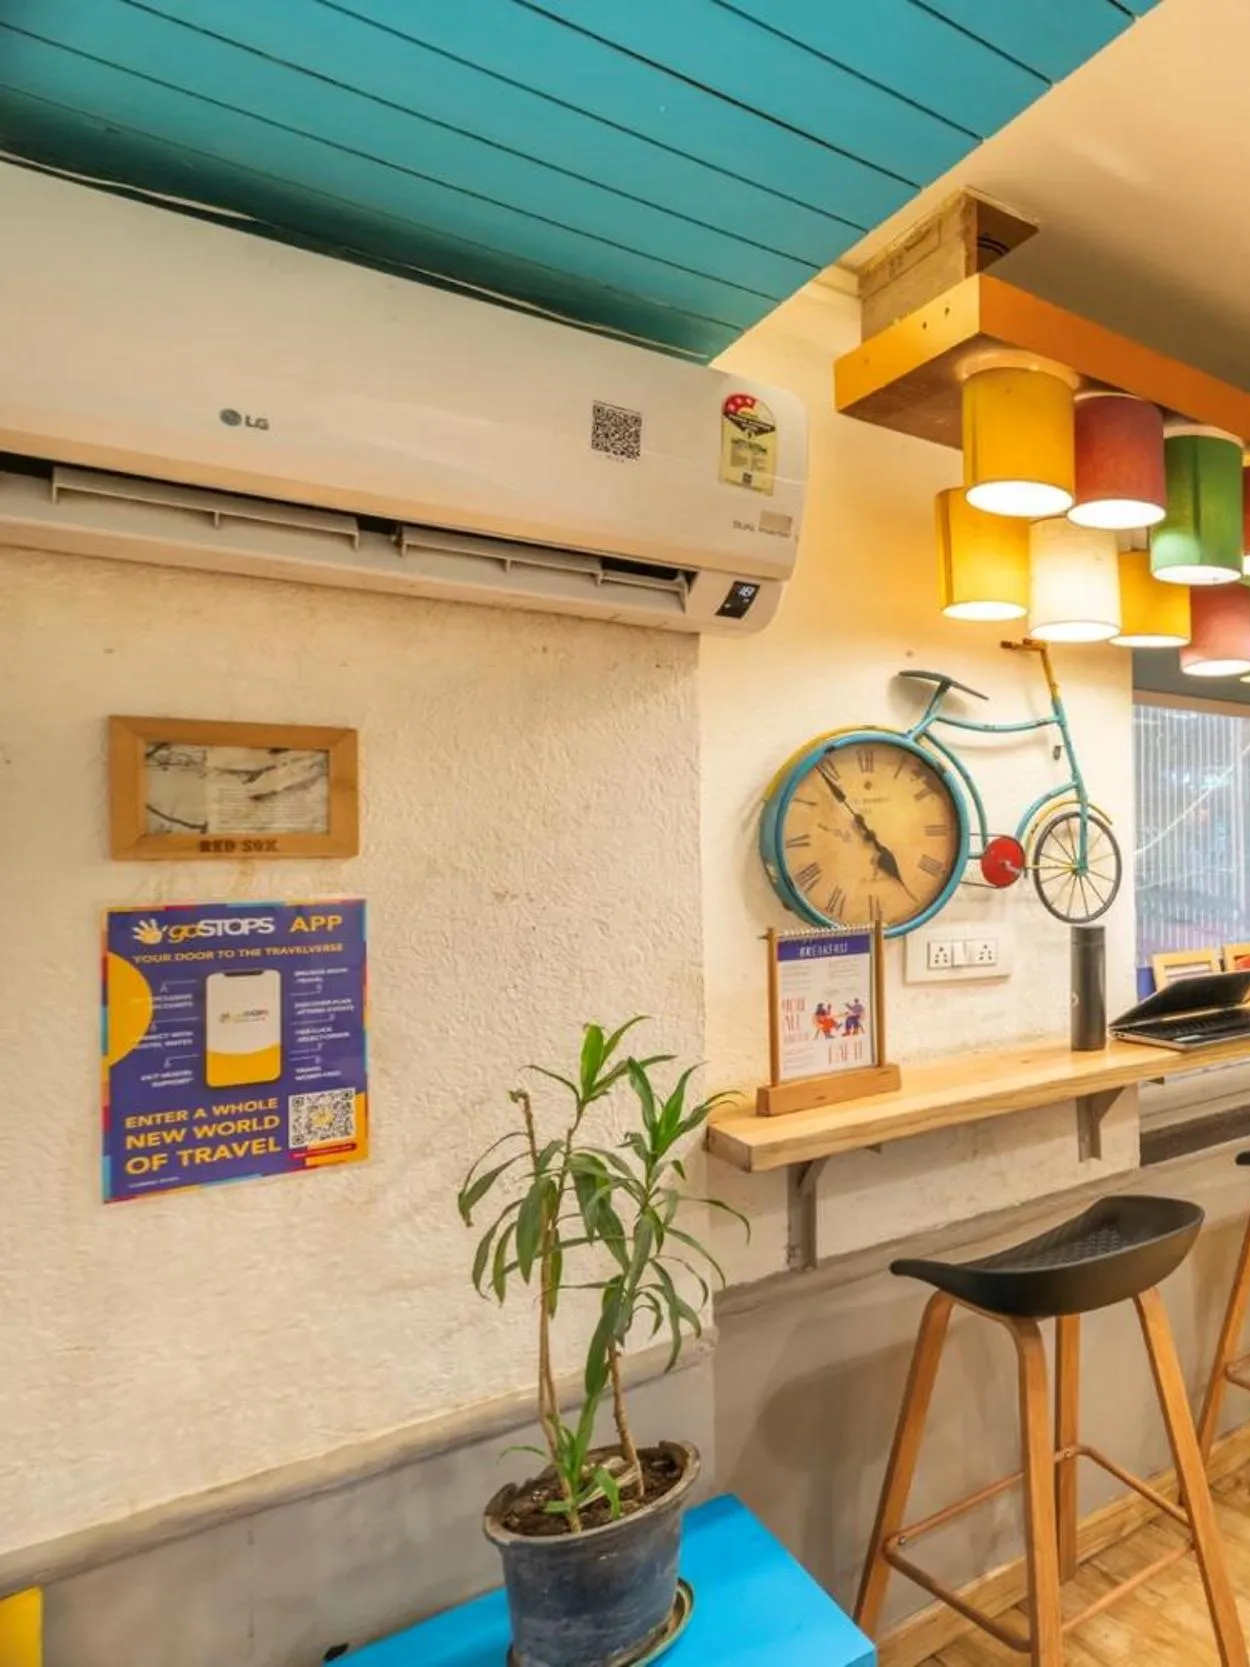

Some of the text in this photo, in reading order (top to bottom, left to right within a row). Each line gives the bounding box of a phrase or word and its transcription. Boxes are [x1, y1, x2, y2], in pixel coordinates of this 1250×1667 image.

[245, 415, 269, 431] LG
[199, 838, 278, 854] RED SOX
[168, 915, 343, 943] goSTOPS APP
[133, 943, 343, 964] YOUR DOOR TO THE TRAVELVERSE
[125, 1097, 279, 1129] ENTER A WHOLE
[125, 1115, 281, 1150] NEW WORLD
[125, 1153, 169, 1175] OF
[176, 1136, 282, 1168] TRAVEL
